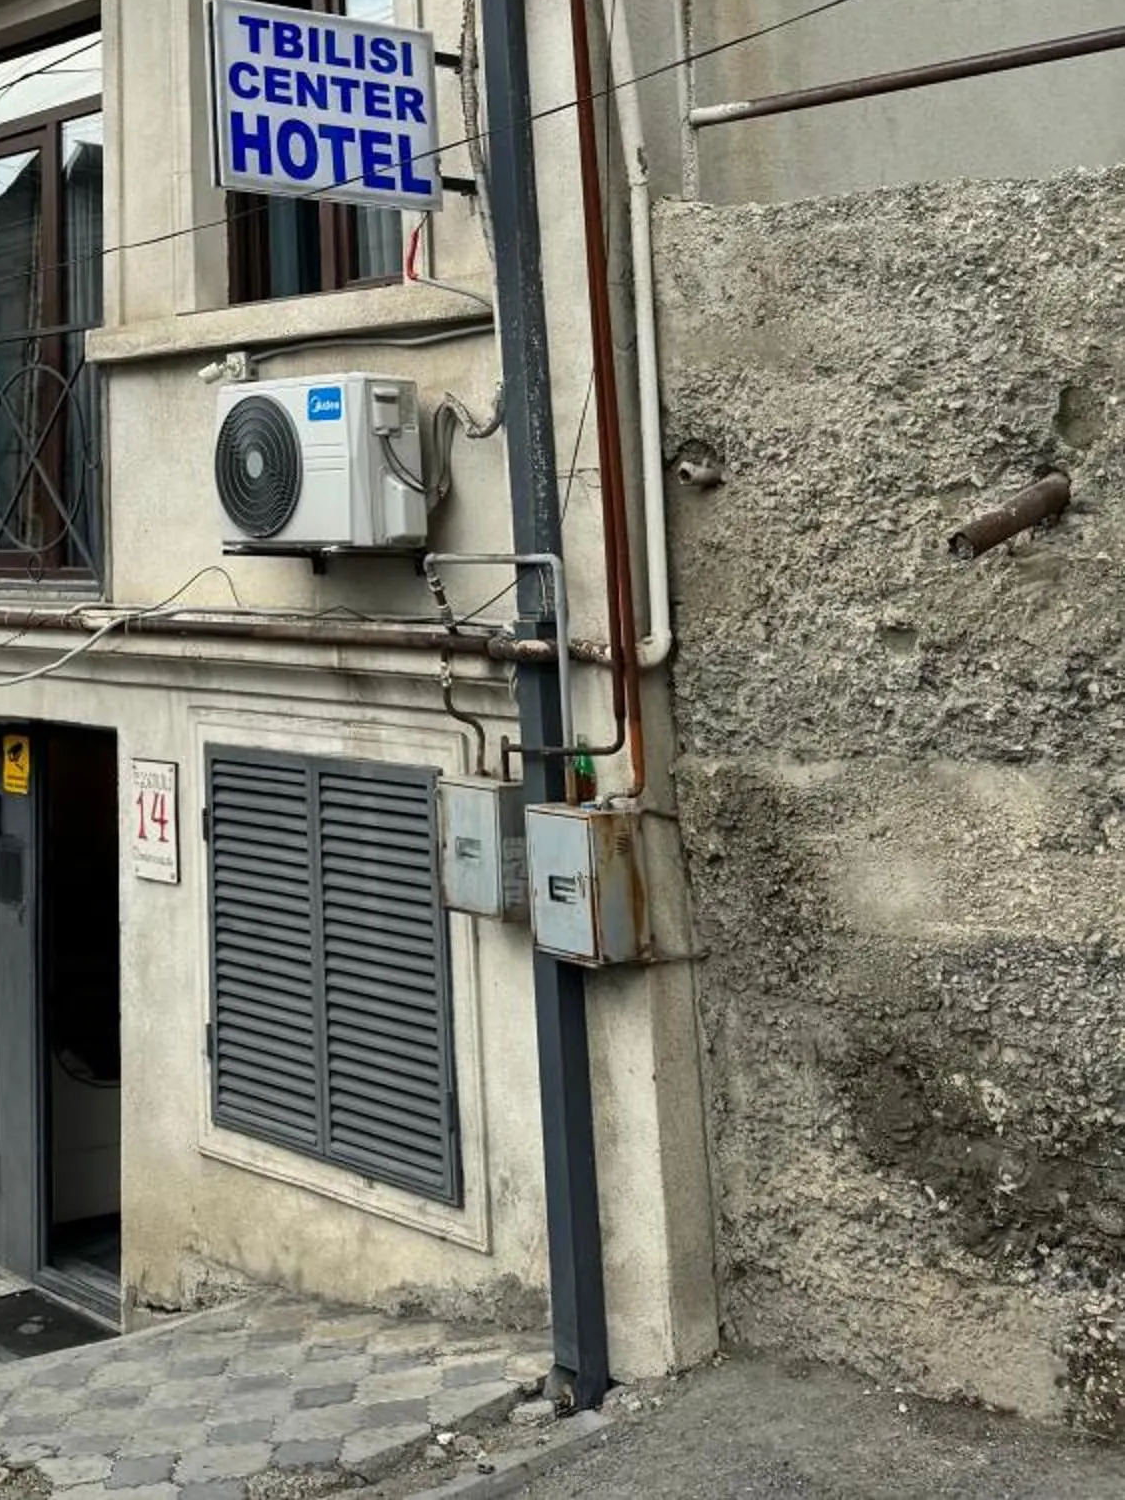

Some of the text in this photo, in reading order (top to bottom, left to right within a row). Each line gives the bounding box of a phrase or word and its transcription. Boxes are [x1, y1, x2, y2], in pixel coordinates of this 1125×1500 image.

[238, 15, 413, 76] TBILISI
[228, 61, 427, 124] CENTER
[230, 111, 432, 195] HOTEL
[136, 790, 169, 843] 14
